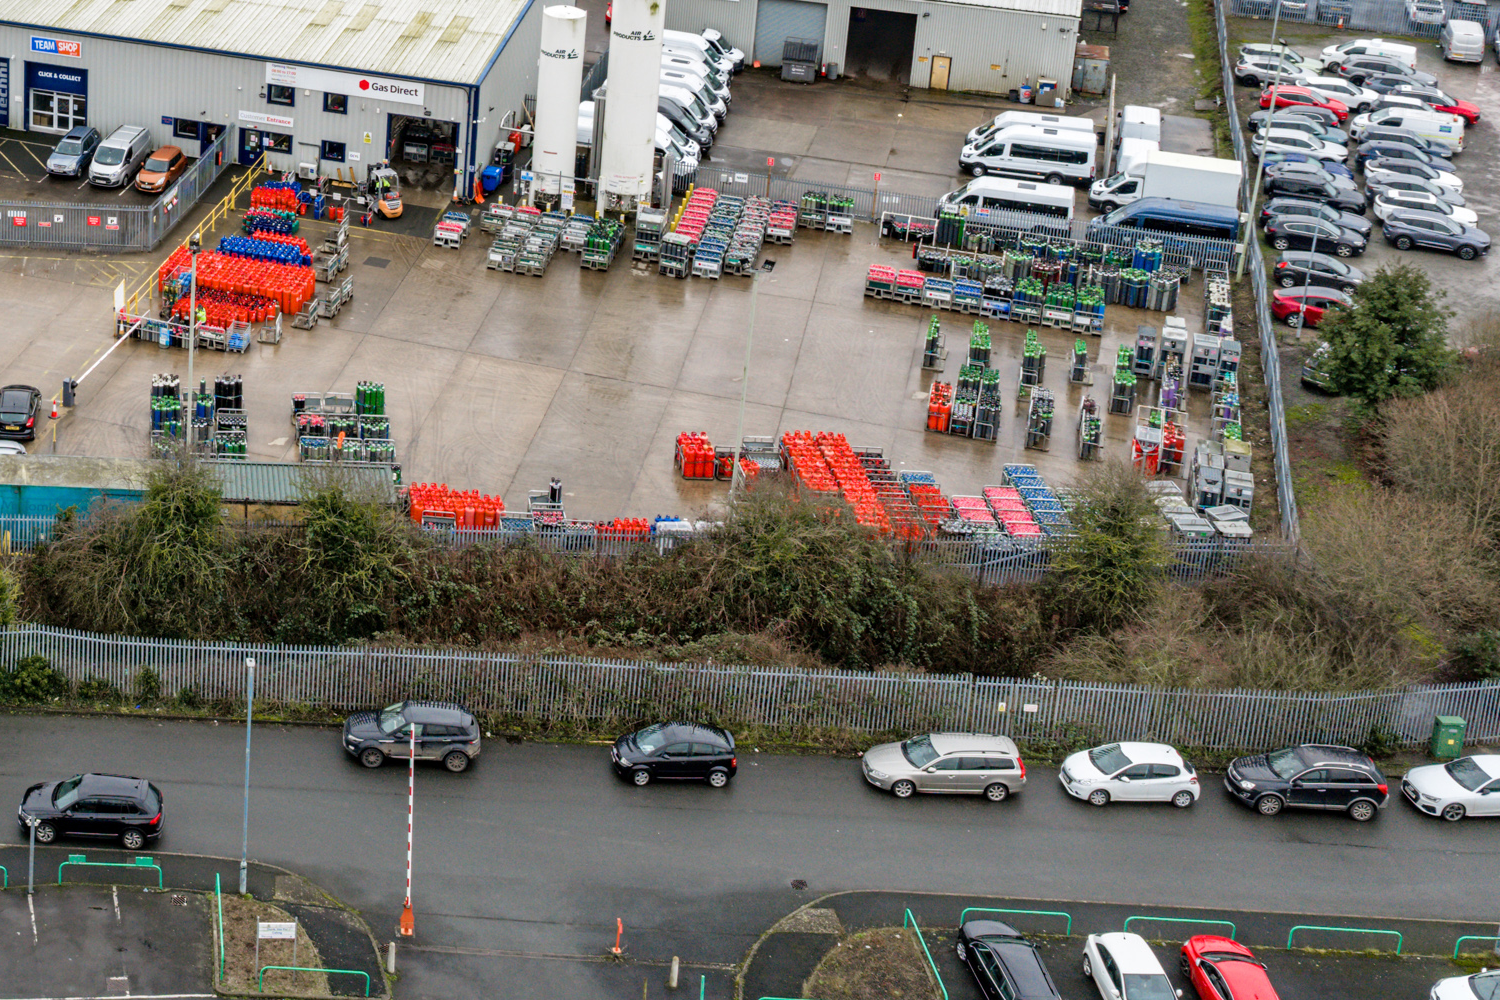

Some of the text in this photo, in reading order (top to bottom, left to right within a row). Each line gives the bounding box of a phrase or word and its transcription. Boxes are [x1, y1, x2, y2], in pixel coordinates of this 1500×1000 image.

[34, 39, 78, 52] TEAM SHOP
[37, 70, 53, 78] CLICK
[58, 73, 82, 82] COLLECT
[371, 82, 419, 97] Gas Direct
[266, 116, 292, 126] Entrance
